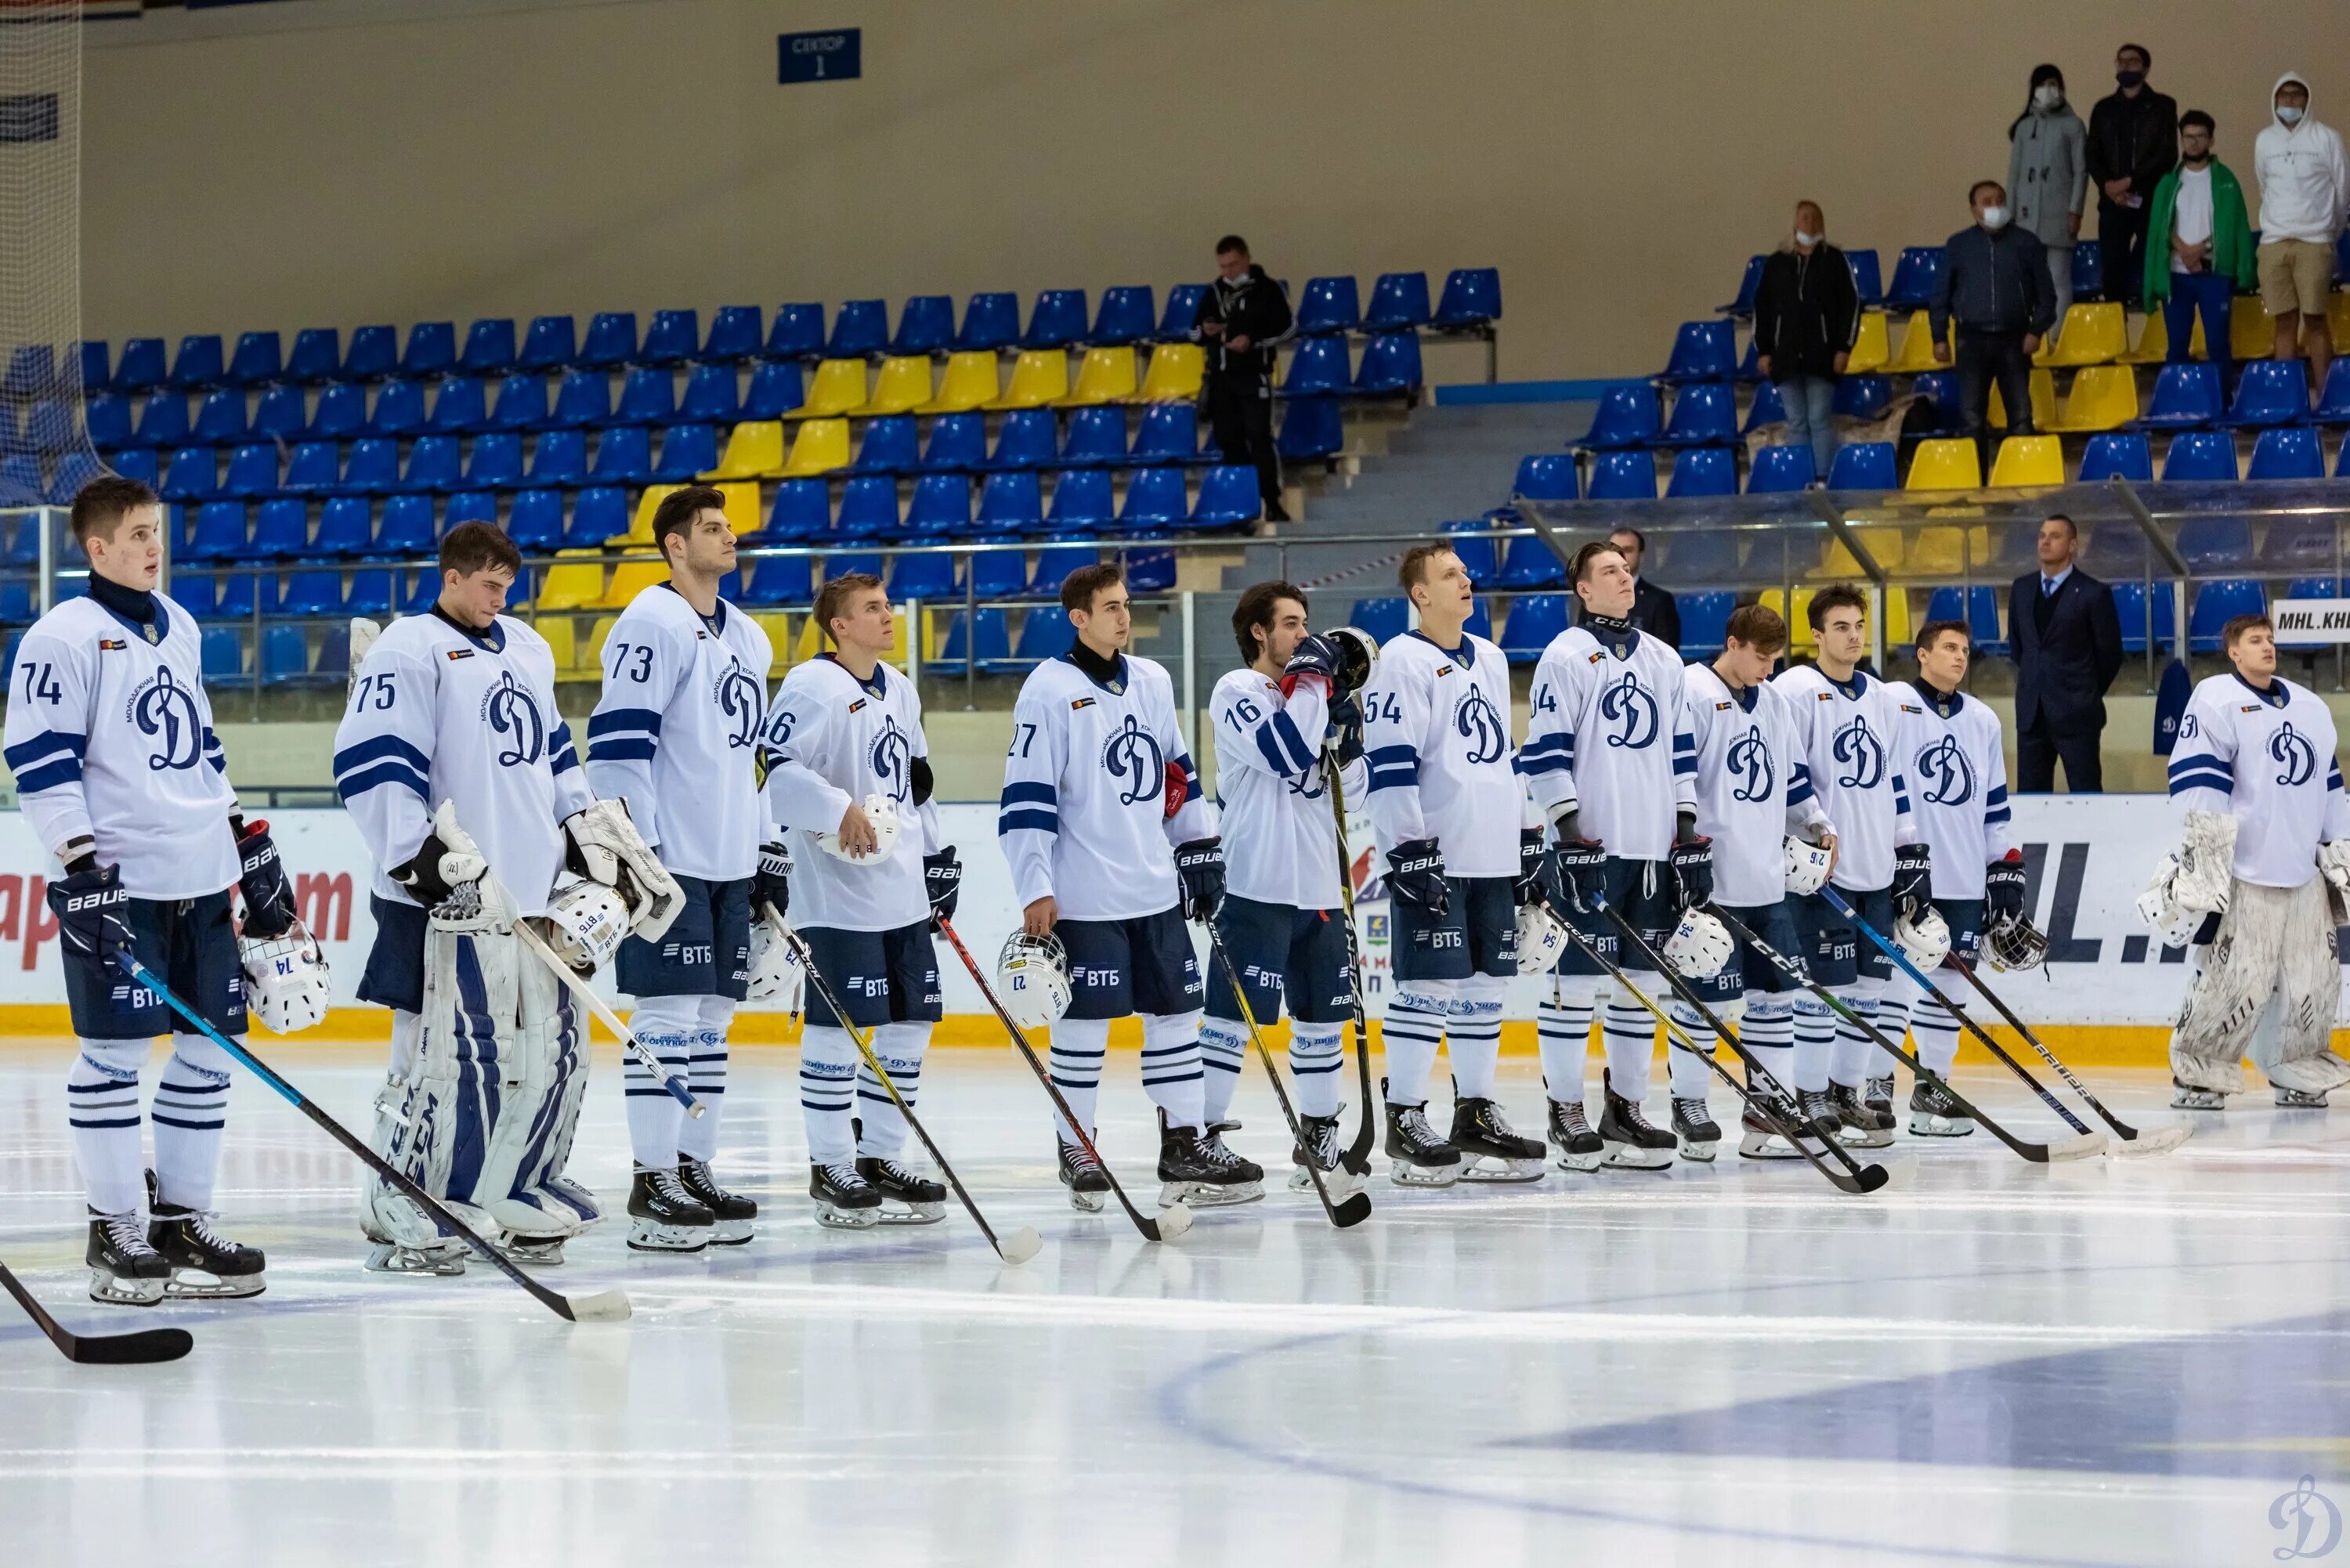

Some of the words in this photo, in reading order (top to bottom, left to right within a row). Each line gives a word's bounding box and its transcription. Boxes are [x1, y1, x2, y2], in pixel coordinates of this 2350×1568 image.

[815, 55, 825, 78] 1
[612, 643, 654, 684] 73
[21, 662, 62, 705] 74
[356, 673, 396, 714] 75
[126, 676, 155, 723] МОЛОДЕЖНАЯ
[1364, 692, 1402, 724] 54
[1224, 697, 1262, 734] 76
[1101, 725, 1123, 768] МОДЕЖНАЯ
[759, 858, 794, 875] WAR
[1400, 854, 1445, 873] BAUE
[1565, 854, 1607, 865] BAUE
[67, 887, 129, 912] BAUE
[579, 915, 598, 934] ВТБ
[1208, 921, 1224, 947] CCM
[1564, 921, 1592, 944] CCM
[1677, 923, 1695, 939] 34
[605, 930, 619, 950] ВТБ
[1432, 930, 1462, 948] ВТБ
[1596, 935, 1618, 953] ВТБ
[682, 945, 711, 965] ВТБ
[1834, 942, 1856, 961] ВТБ
[800, 953, 821, 978] CCM
[1750, 938, 1815, 988] CCM
[866, 977, 889, 997] ВТБ
[1013, 975, 1026, 991] 27
[1086, 969, 1120, 987] ВТБ
[1259, 970, 1283, 990] ВТБ
[1718, 973, 1742, 991] ВТБ
[2033, 1042, 2092, 1100] BAUER
[2040, 1089, 2084, 1131] BAUER
